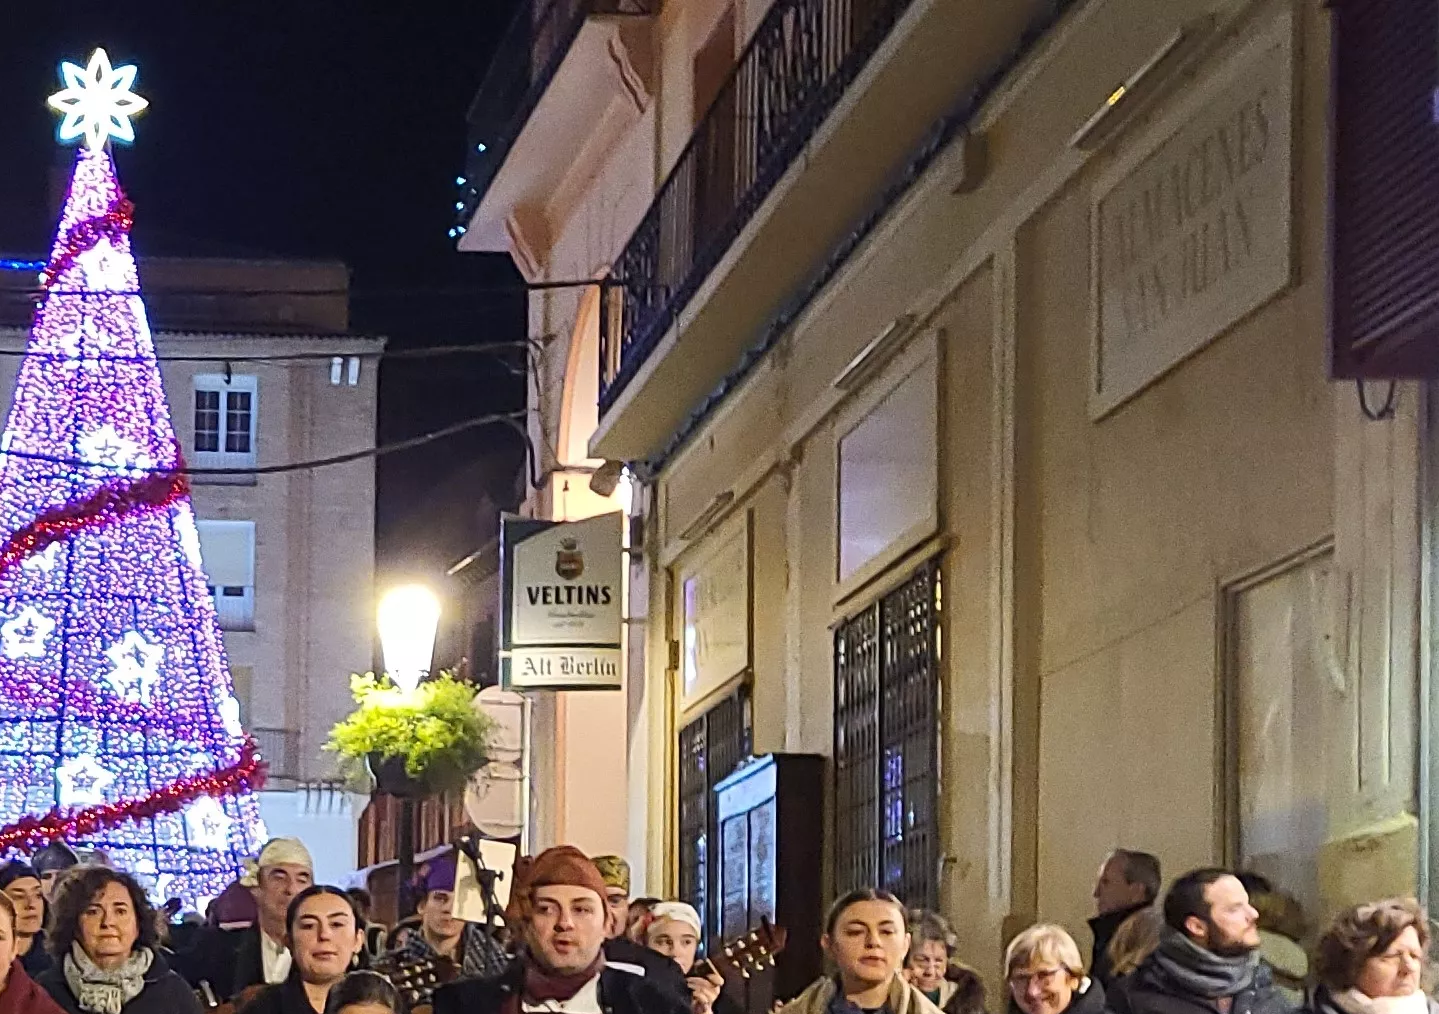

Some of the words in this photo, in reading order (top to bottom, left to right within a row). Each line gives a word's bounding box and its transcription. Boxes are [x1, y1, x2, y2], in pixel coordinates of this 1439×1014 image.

[527, 586, 611, 605] VELTINS
[522, 657, 552, 676] Alt
[559, 656, 617, 676] Berlin
